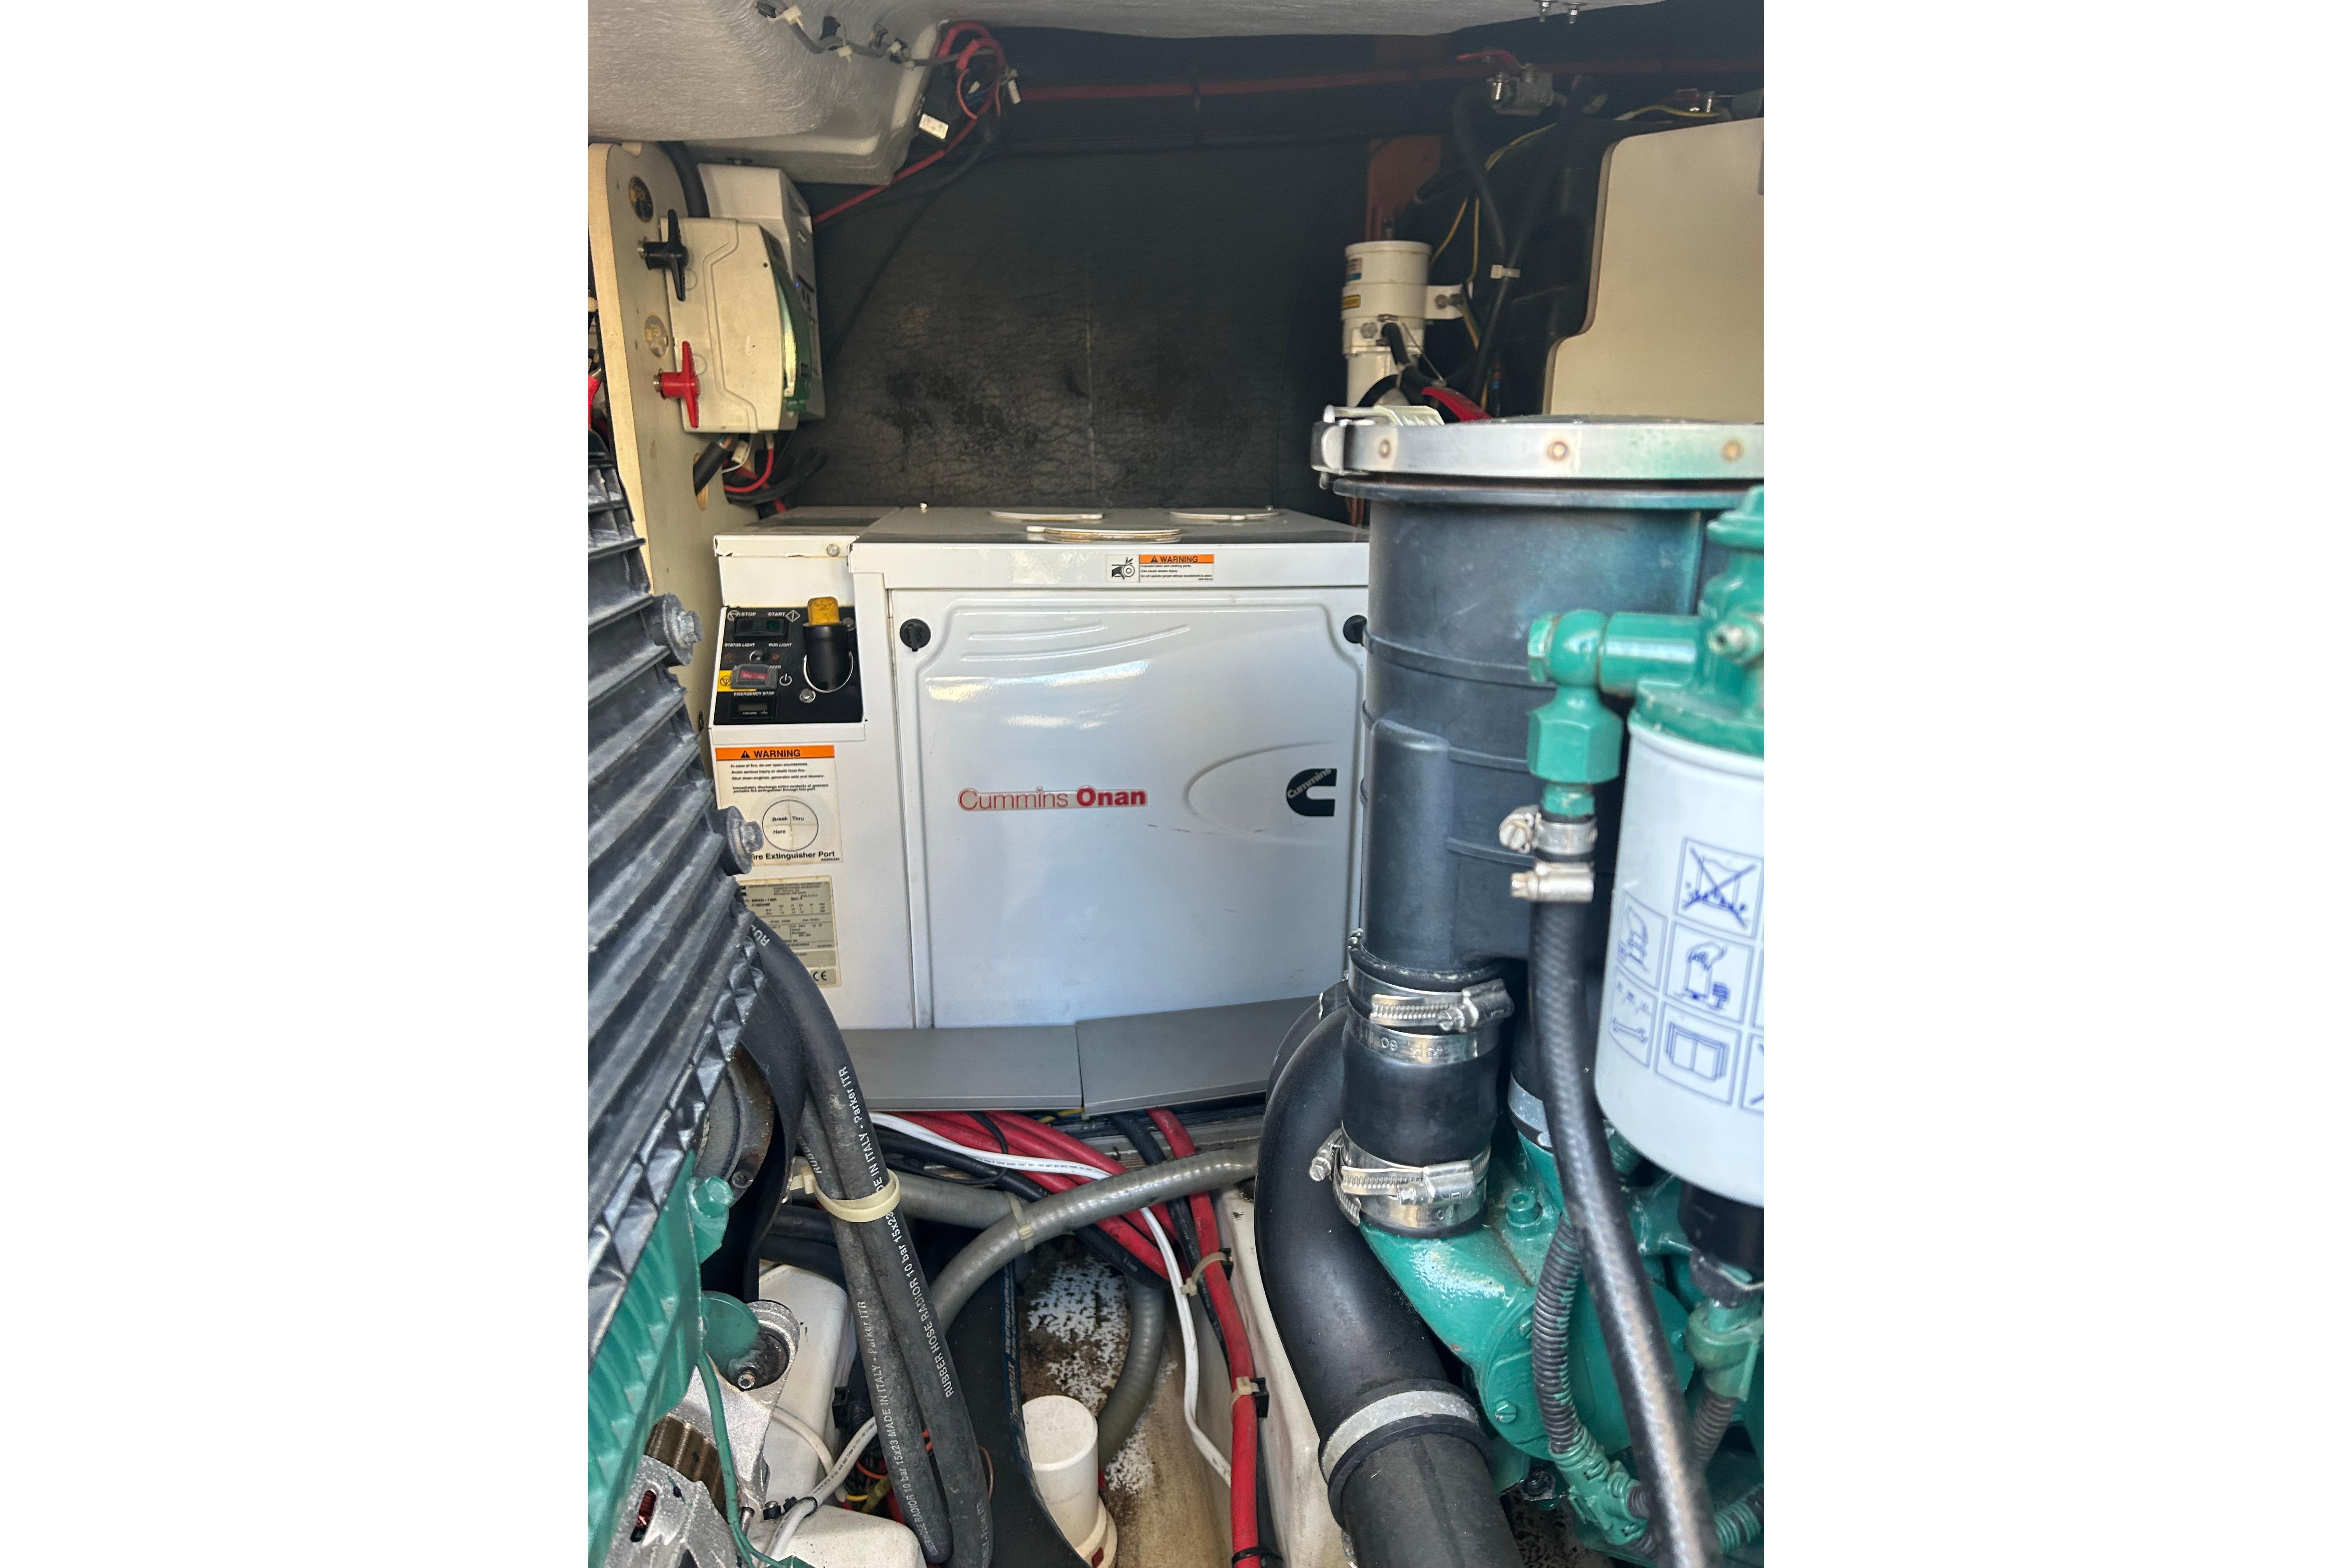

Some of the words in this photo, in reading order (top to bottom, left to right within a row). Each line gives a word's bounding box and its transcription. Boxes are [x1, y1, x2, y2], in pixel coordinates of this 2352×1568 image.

[753, 749, 801, 758] WARNING
[1287, 768, 1332, 798] Cummins
[959, 786, 1069, 809] Cummins
[1077, 787, 1146, 807] Onan
[766, 852, 816, 860] Extinguisher
[813, 971, 828, 982] CE
[839, 1066, 851, 1087] ITR
[847, 1088, 863, 1123] Parker
[859, 1132, 875, 1163] ITALY
[869, 1163, 879, 1177] IN
[886, 1211, 902, 1243] 15x23
[898, 1244, 910, 1263] bar
[905, 1264, 914, 1277] 10
[857, 1302, 869, 1318] ITR
[910, 1277, 929, 1321] RADIOR
[863, 1321, 877, 1354] Parker
[924, 1321, 940, 1353] HOSE
[872, 1365, 886, 1392] ITALY
[934, 1352, 954, 1398] RUBBER
[878, 1395, 889, 1405] IN
[882, 1409, 896, 1437] MADE
[899, 1468, 909, 1481] bar
[903, 1483, 912, 1493] 10
[906, 1494, 923, 1522] RADIOR
